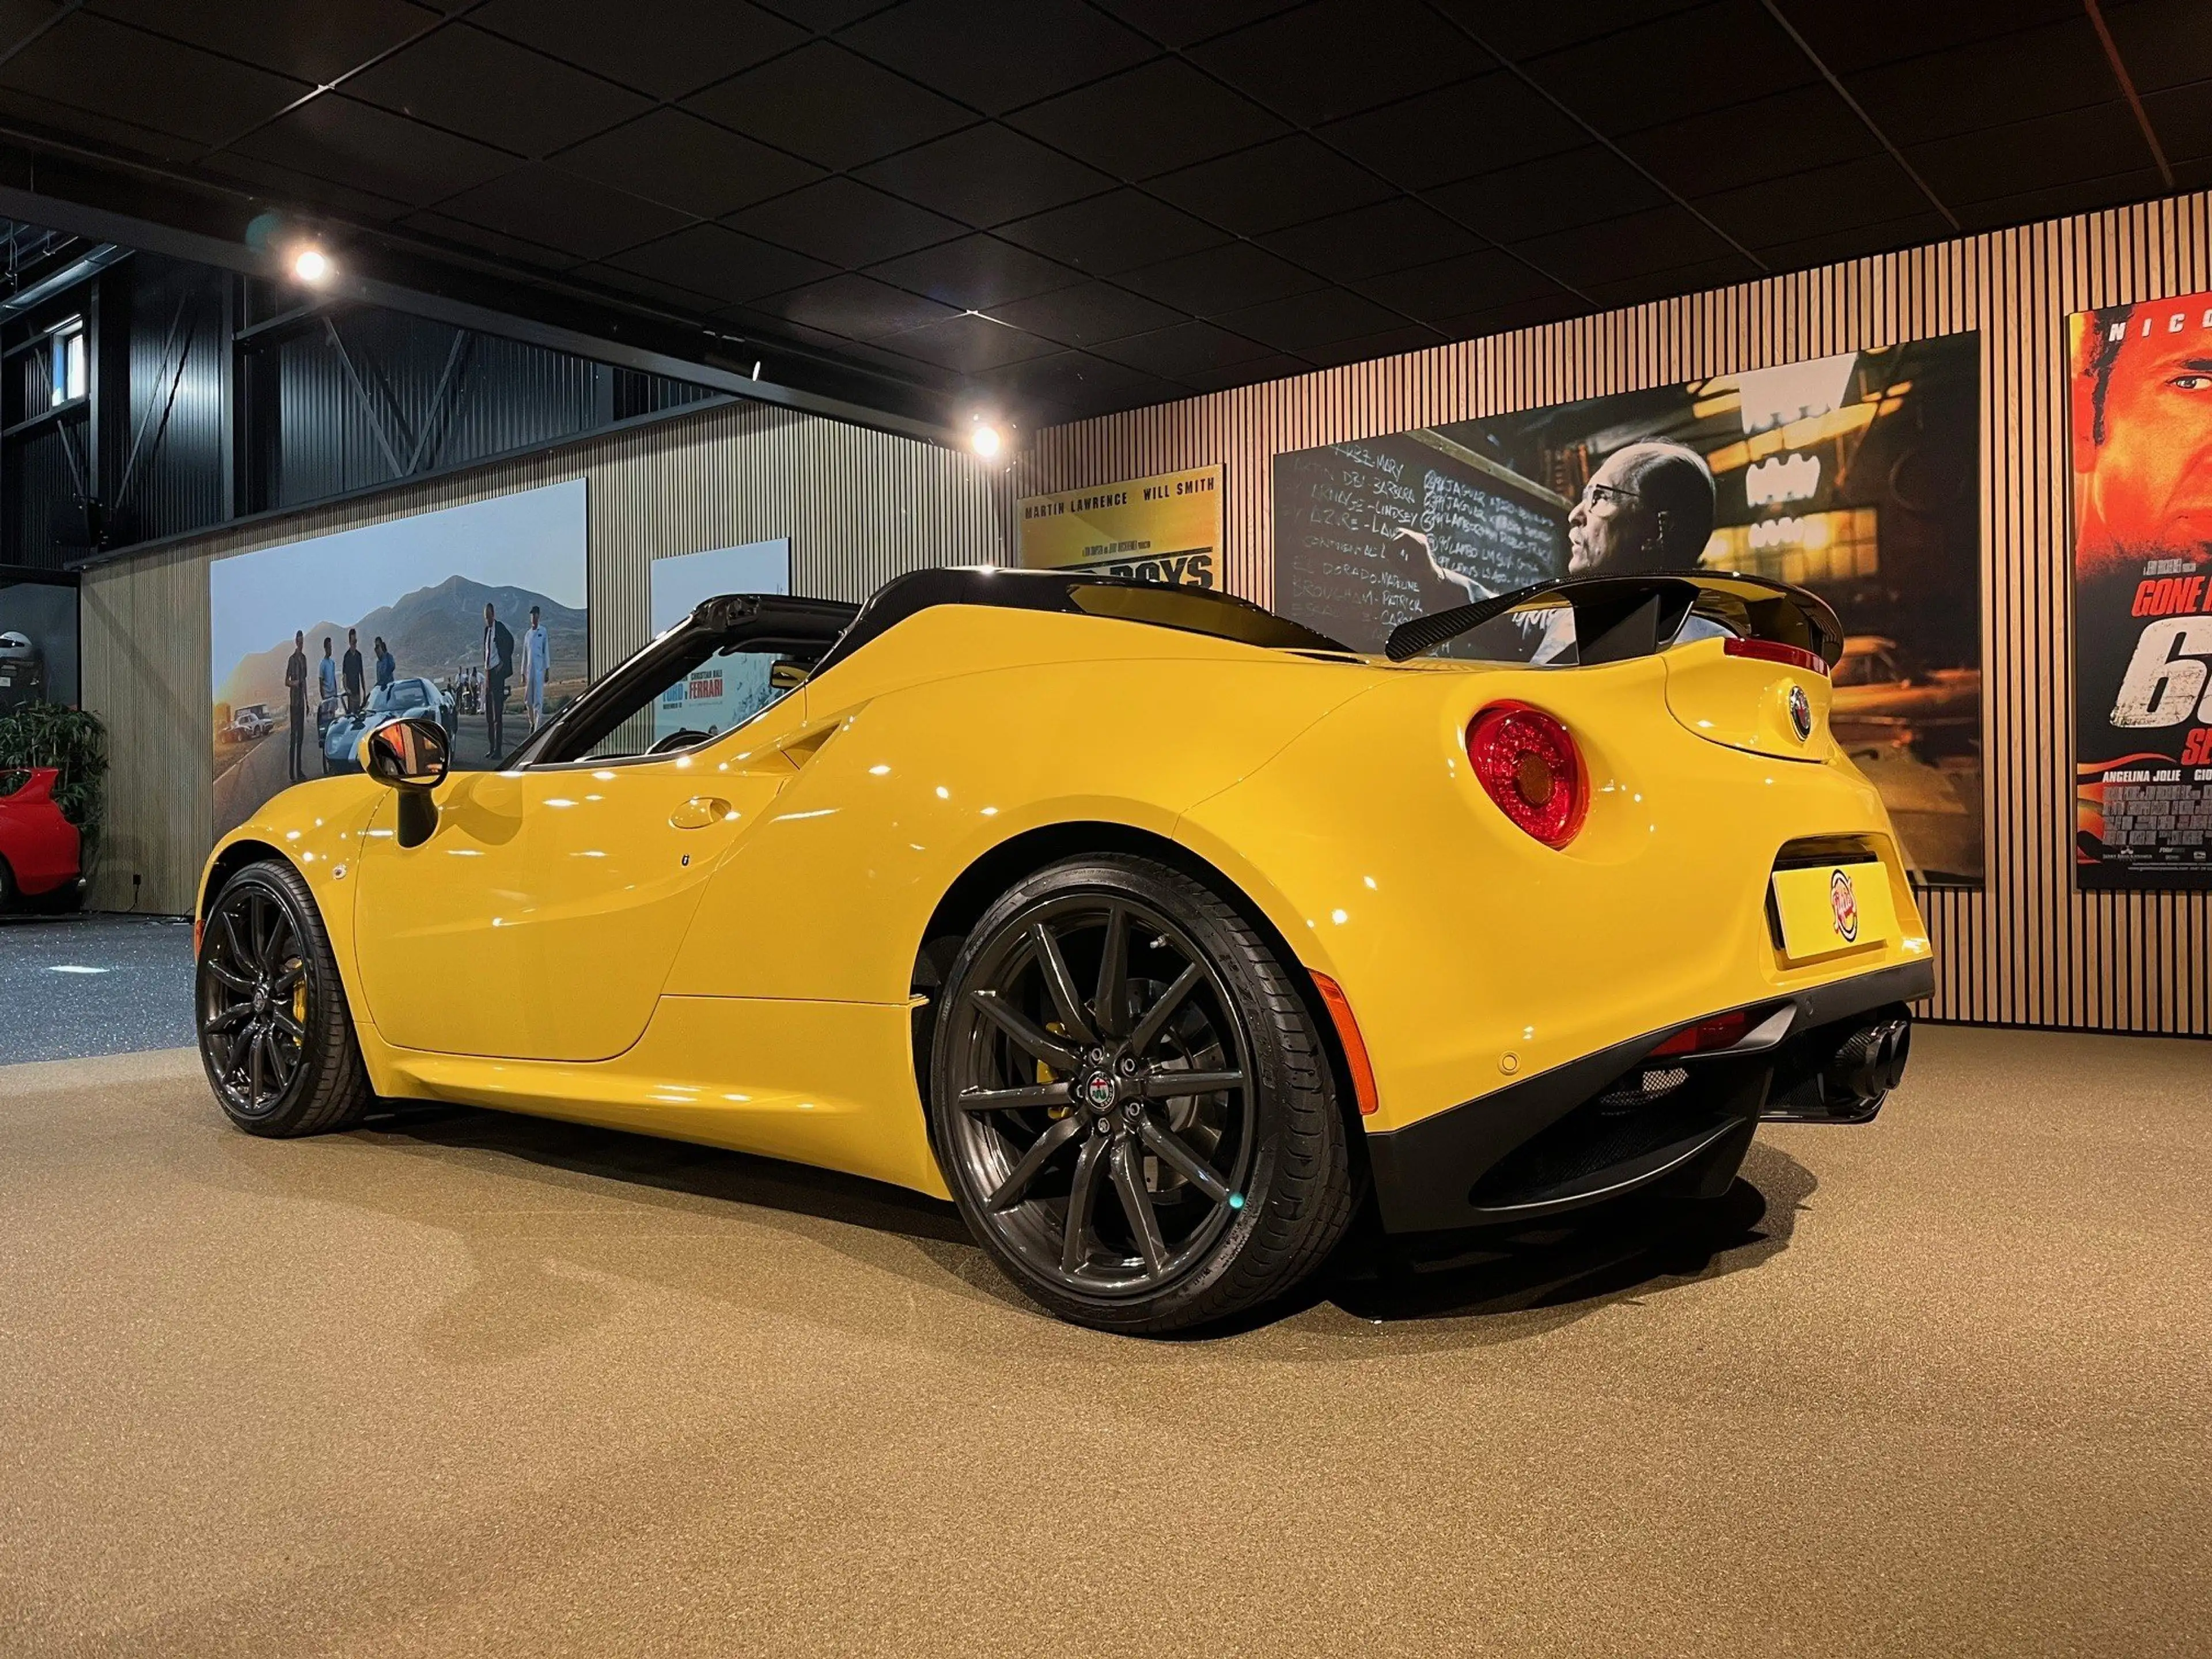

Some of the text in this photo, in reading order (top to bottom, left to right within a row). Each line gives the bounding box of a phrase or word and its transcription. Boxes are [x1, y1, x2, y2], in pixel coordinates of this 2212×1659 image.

[1025, 477, 1214, 519] MARTIN LAWRENCE WILL SMITH
[2131, 576, 2206, 616] GONE
[690, 679, 723, 699] FERRARI
[2103, 770, 2150, 783] ANGELINA
[2153, 770, 2181, 782] JOLIE
